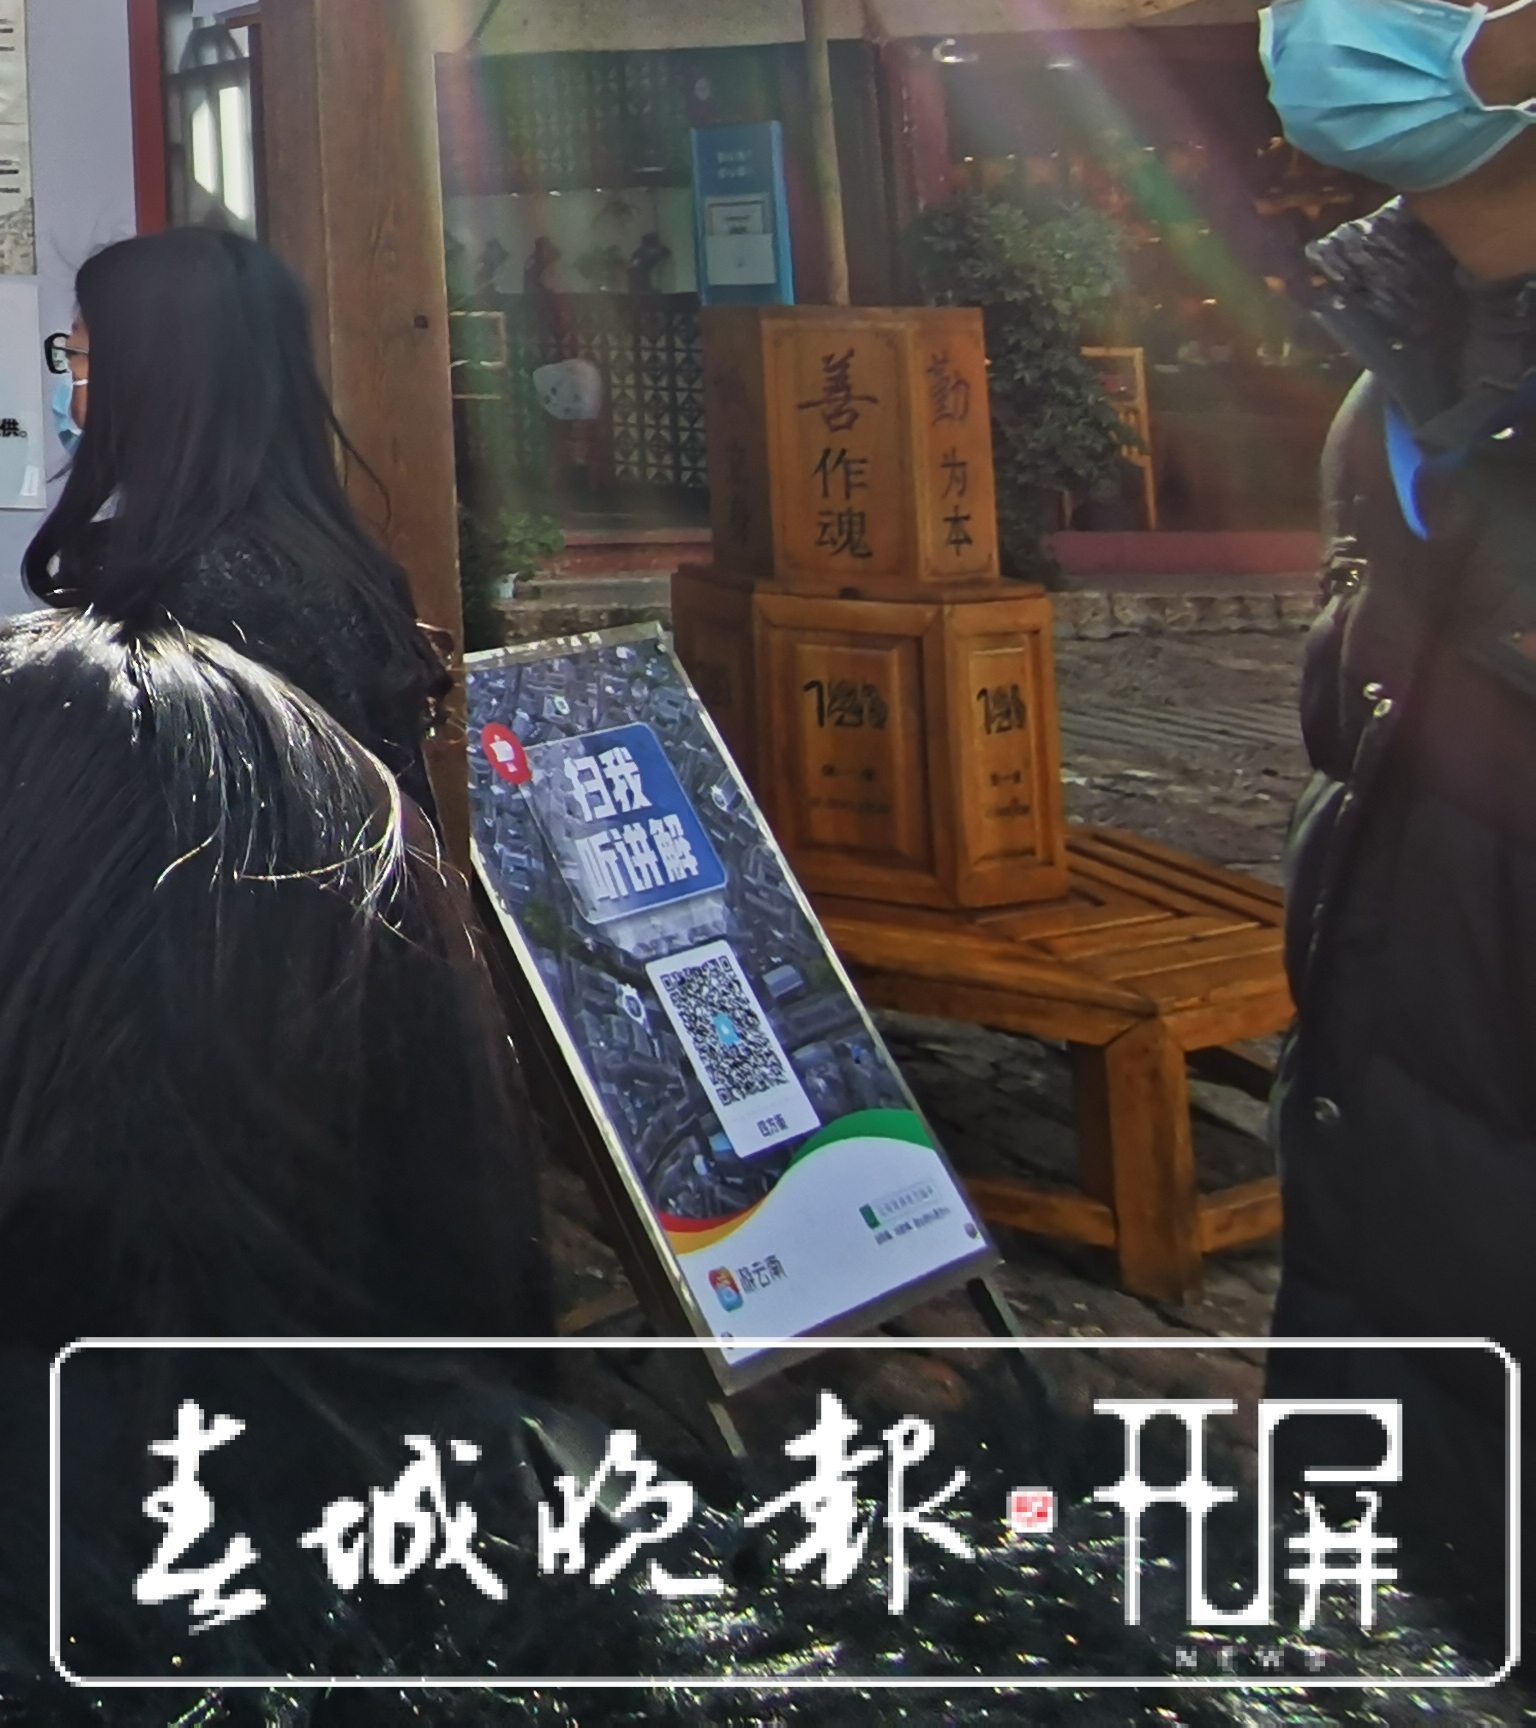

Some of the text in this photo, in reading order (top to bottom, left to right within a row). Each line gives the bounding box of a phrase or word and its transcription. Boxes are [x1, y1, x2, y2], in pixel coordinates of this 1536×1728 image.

[797, 348, 879, 559] 善作魂
[927, 349, 974, 557] 勤为本
[563, 746, 653, 822] 扫我
[574, 813, 699, 901] 听讲解
